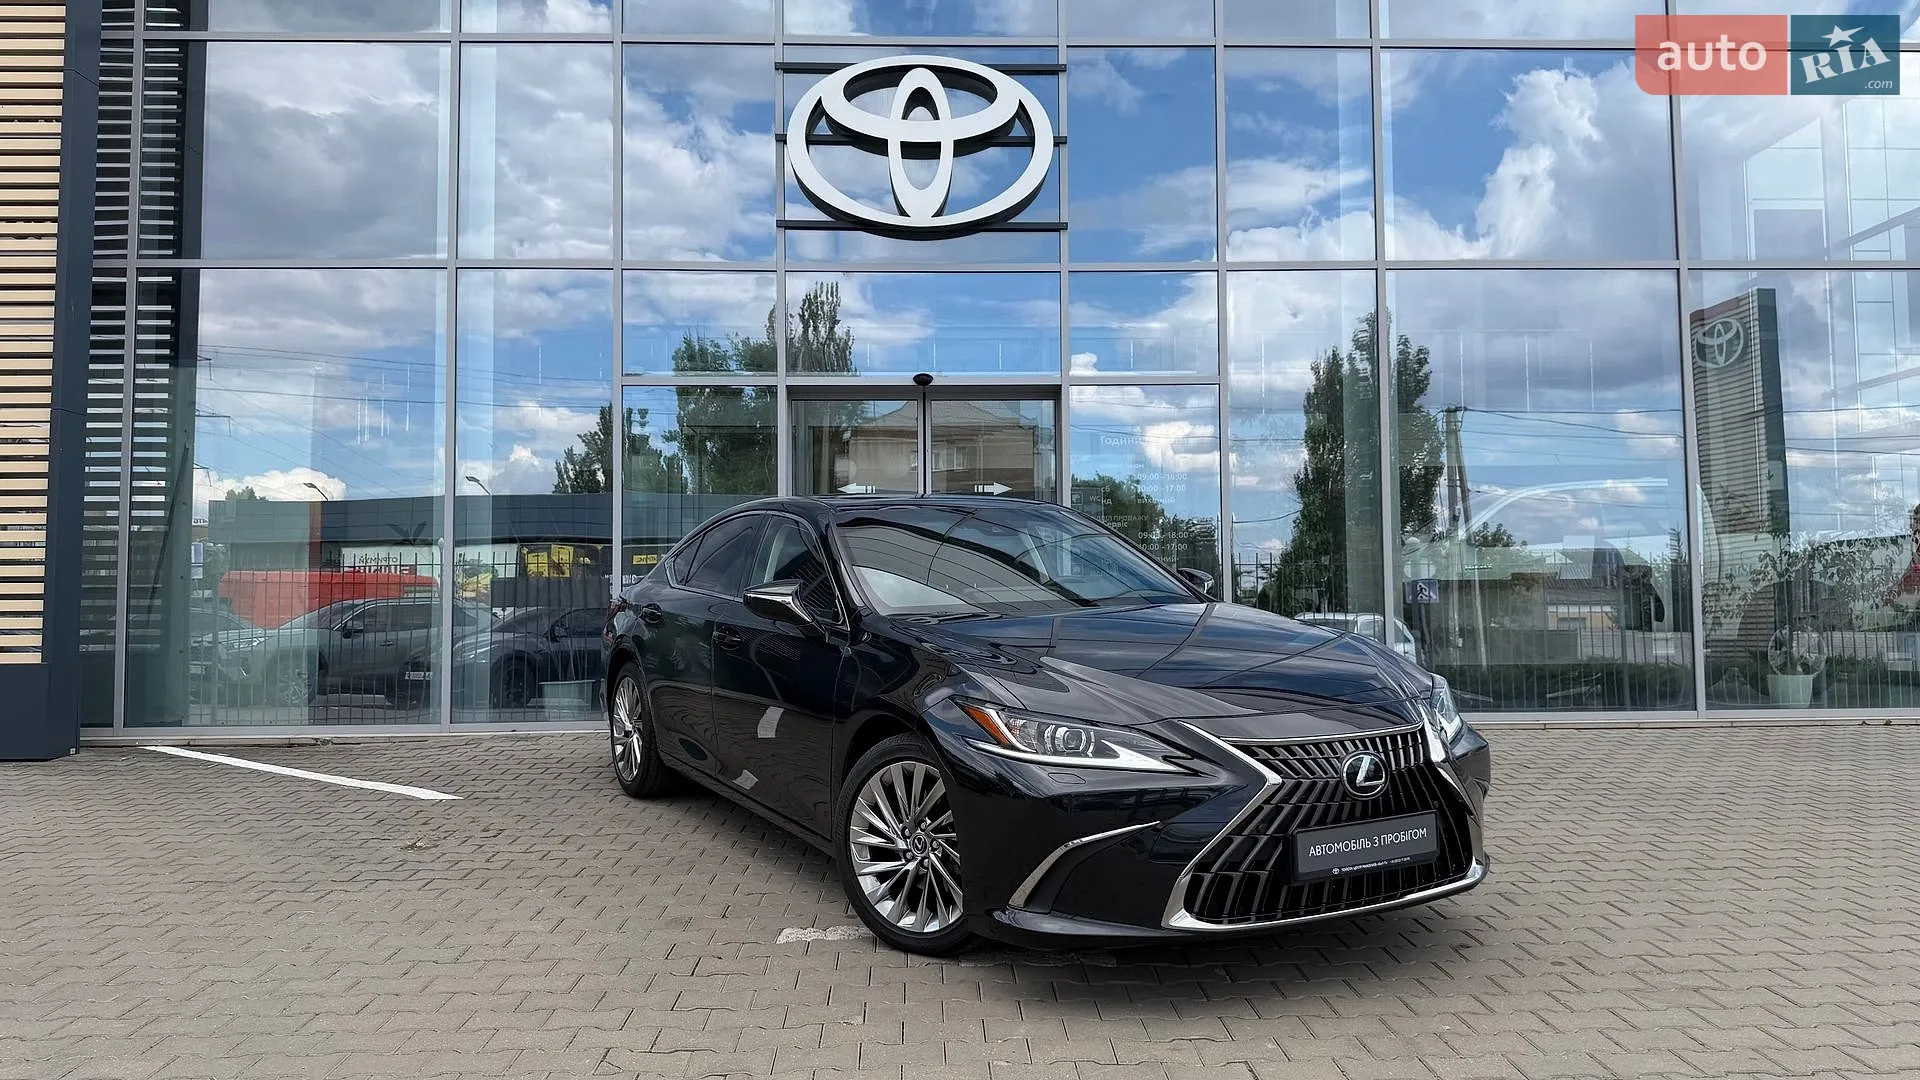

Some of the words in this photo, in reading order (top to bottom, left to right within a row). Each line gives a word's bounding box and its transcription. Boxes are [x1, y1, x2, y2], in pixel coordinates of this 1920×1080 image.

[1168, 531, 1188, 539] 18:00
[1167, 543, 1188, 551] 17:00
[1308, 837, 1372, 857] АВТОМОБІЛЬ
[1380, 827, 1427, 846] ПРОБІГОМ
